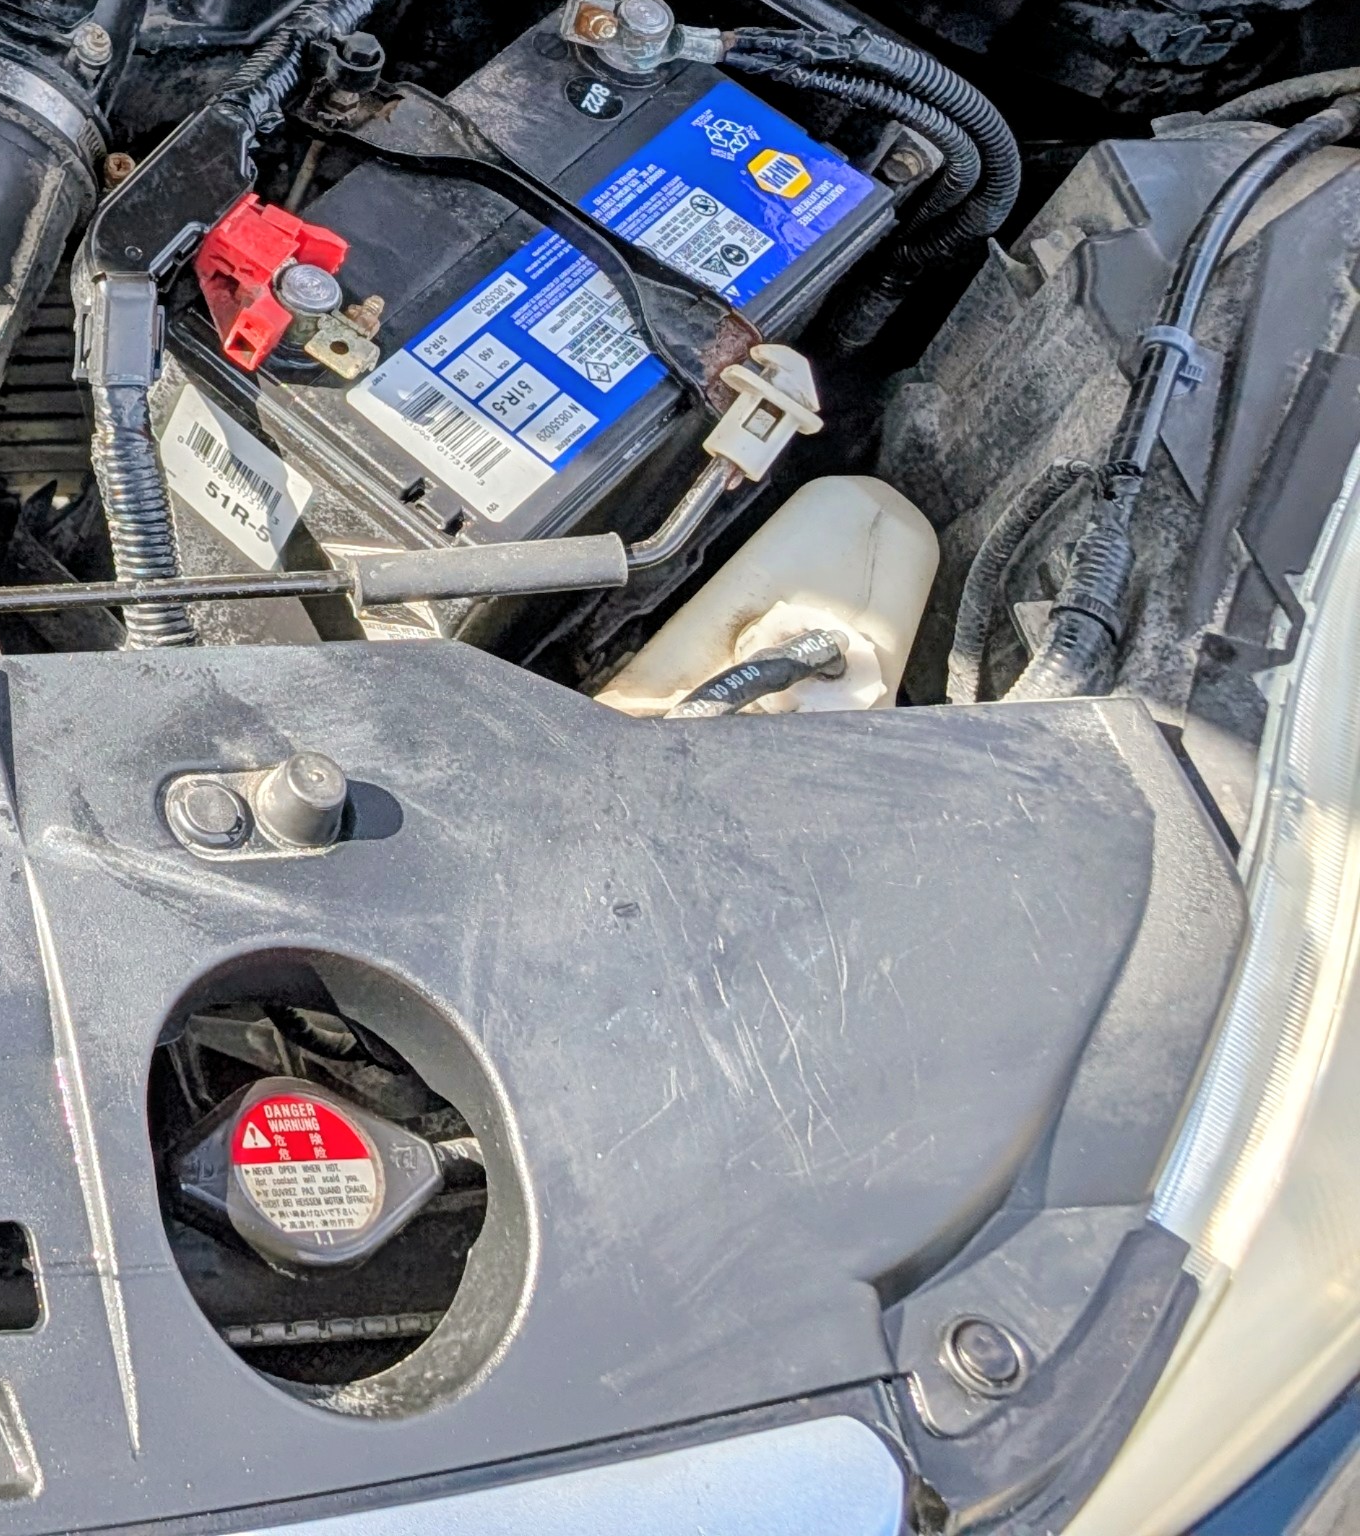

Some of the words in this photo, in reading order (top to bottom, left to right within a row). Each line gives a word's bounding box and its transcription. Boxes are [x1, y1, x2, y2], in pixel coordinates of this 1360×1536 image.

[581, 84, 609, 112] 8/22
[758, 156, 800, 190] NAPA
[815, 179, 833, 194] SANS
[796, 212, 815, 227] FREE
[504, 277, 516, 287] N
[470, 284, 509, 315] 0835029
[421, 333, 448, 356] 51R-5
[476, 346, 496, 362] 450
[496, 359, 510, 371] CCA
[451, 367, 470, 383] 555
[473, 380, 484, 389] CA
[489, 378, 533, 416] 51R-5
[566, 403, 580, 413] N
[533, 409, 574, 442] 0835029
[202, 479, 272, 543] 51R-5
[485, 501, 499, 513] 12V
[264, 1103, 316, 1118] DANGER
[268, 1118, 320, 1132] WARNUNG
[252, 1166, 273, 1175] NEVER
[279, 1166, 297, 1174] OPEN
[303, 1165, 321, 1173] WHEN
[326, 1164, 341, 1172] HOT.
[255, 1177, 267, 1186] Hot
[272, 1176, 298, 1185] coolant
[303, 1175, 316, 1184] will
[322, 1174, 339, 1183] scald
[345, 1176, 359, 1184] you.
[301, 1187, 315, 1196] PAS
[318, 1186, 341, 1195] QUAND
[283, 1199, 294, 1207] BEI
[314, 1231, 334, 1245] 1.1
